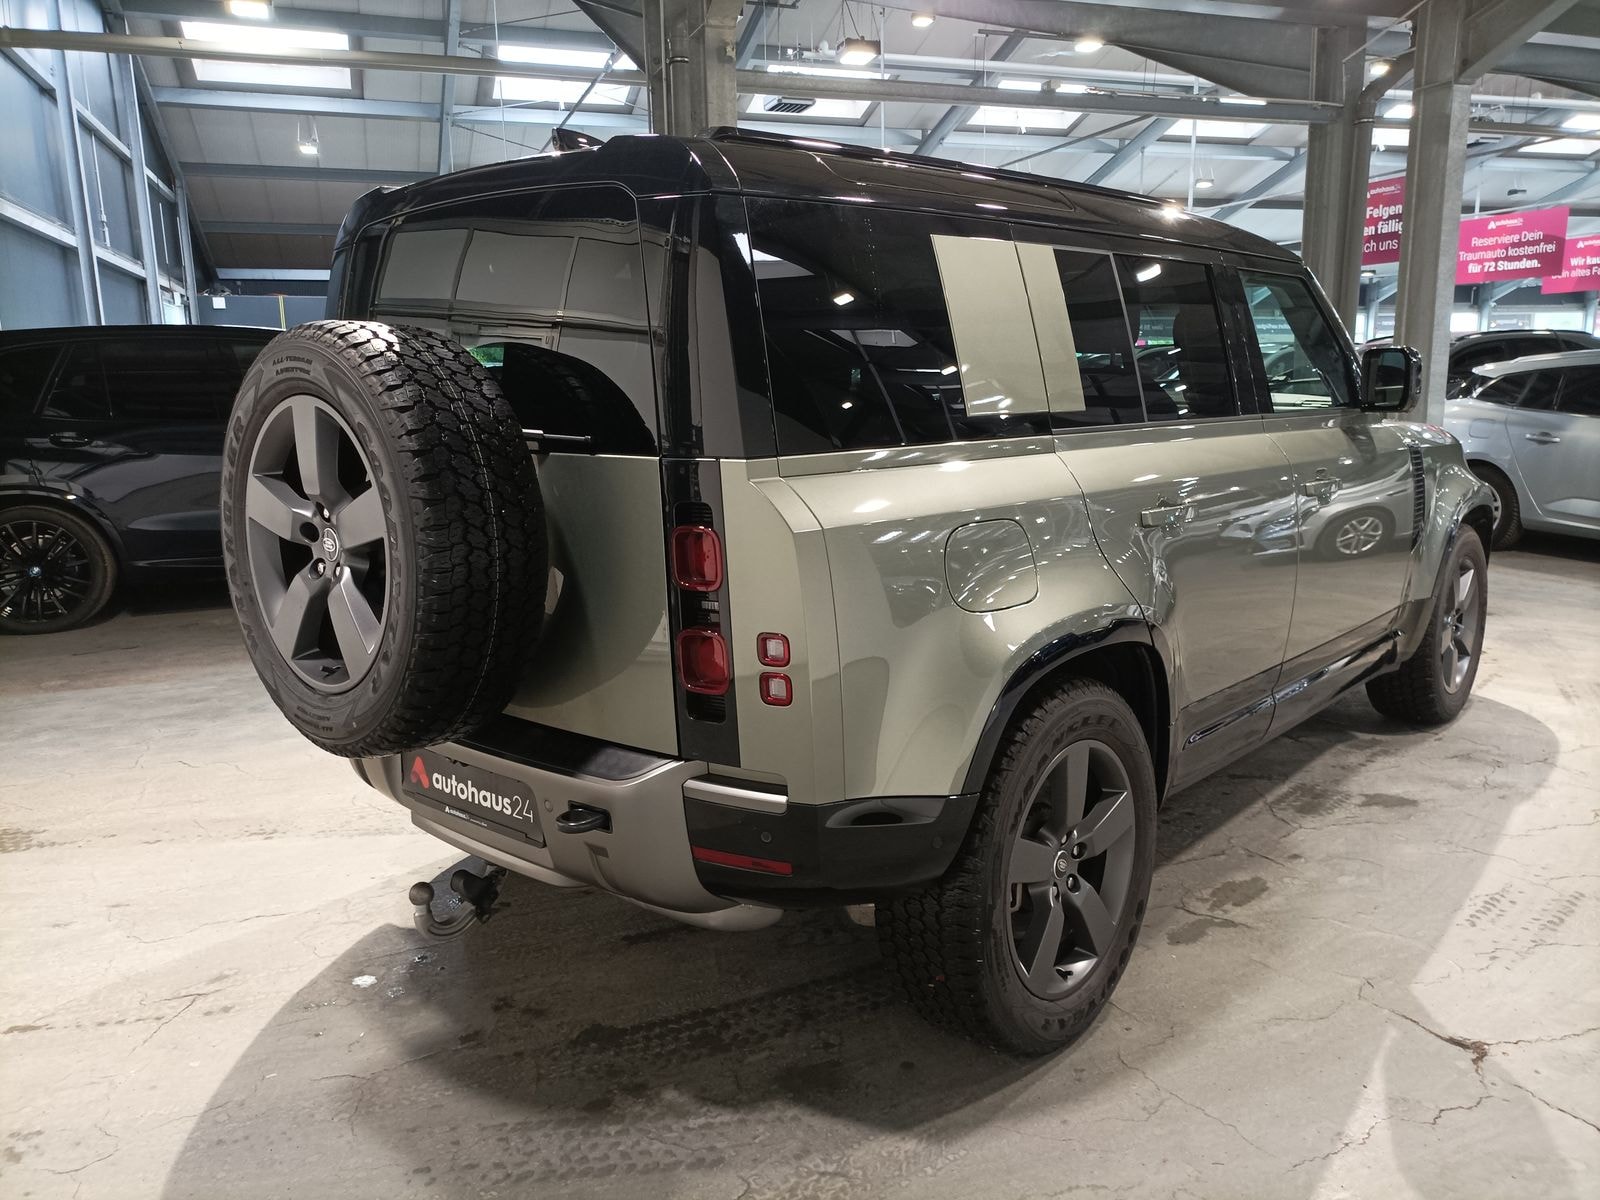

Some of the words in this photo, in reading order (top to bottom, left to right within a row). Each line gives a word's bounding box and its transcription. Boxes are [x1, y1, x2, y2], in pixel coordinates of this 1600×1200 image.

[1366, 204, 1403, 219] Felgen
[1378, 239, 1399, 251] uns
[1471, 234, 1520, 247] Reserviere
[1521, 230, 1543, 242] Dein
[1459, 248, 1507, 262] Traumauto
[1508, 241, 1556, 257] kostenfrei
[1467, 262, 1482, 274] für
[1483, 262, 1496, 272] 72
[1497, 258, 1541, 271] Stunden.
[1570, 257, 1585, 267] Wir
[1570, 268, 1591, 278] altes
[432, 772, 534, 823] autohaus24
